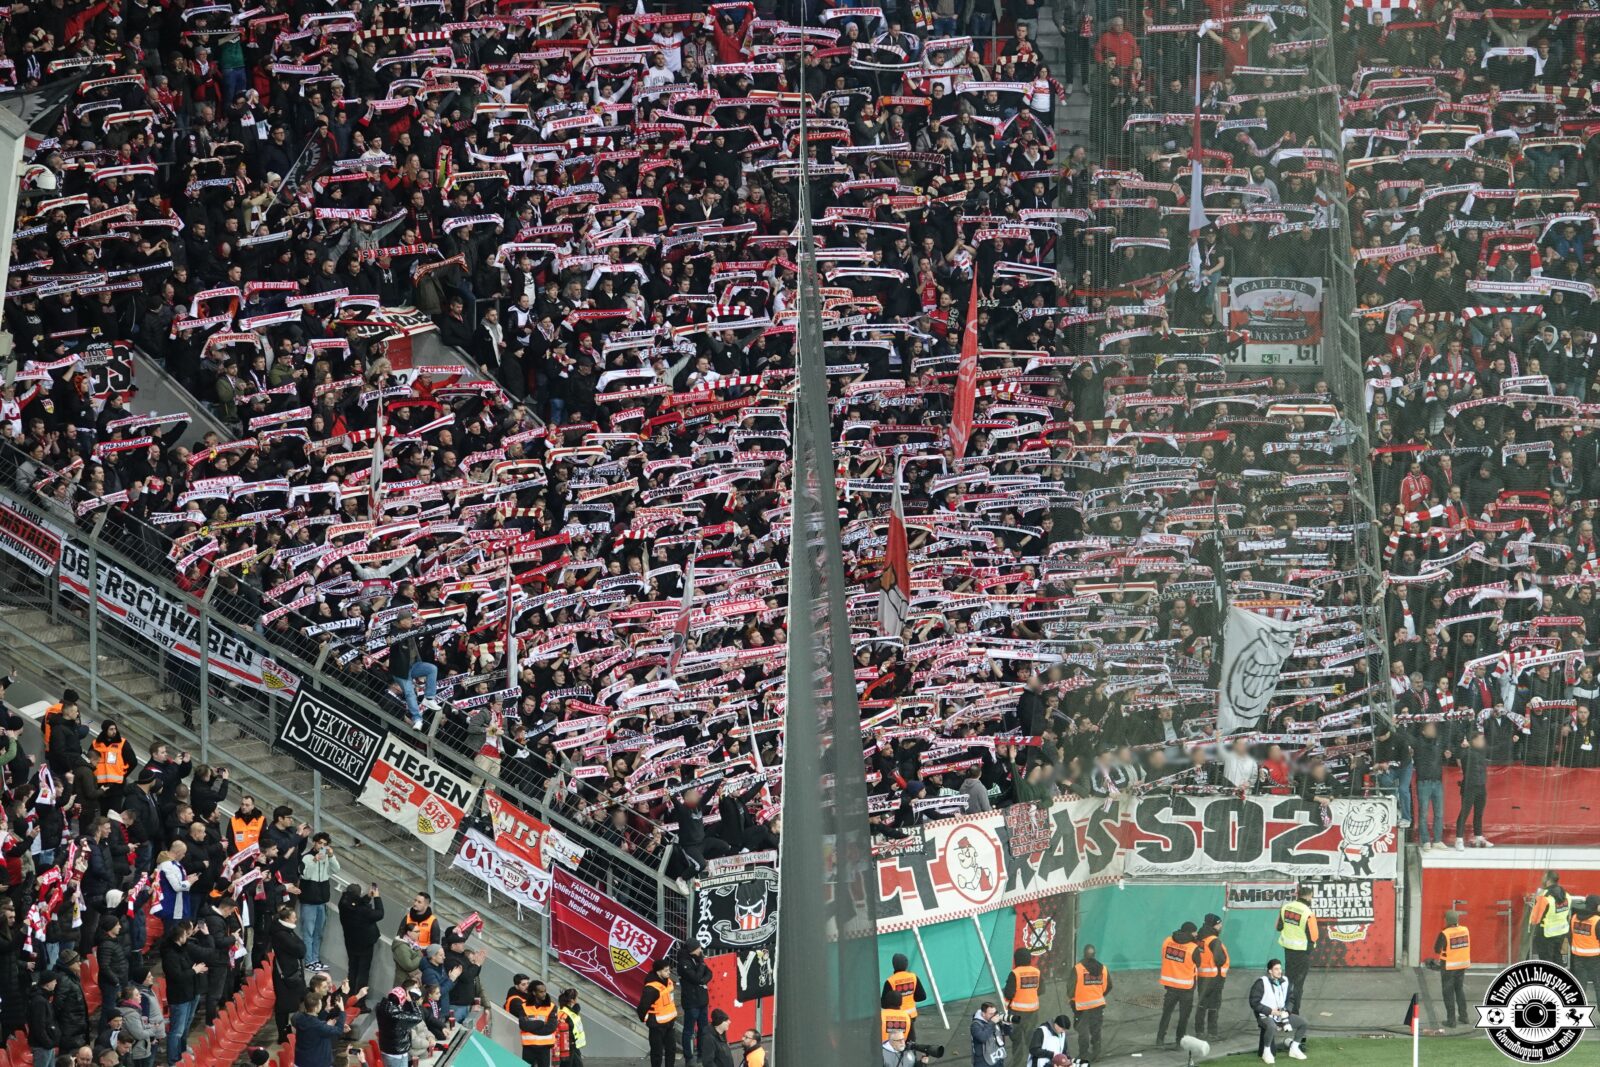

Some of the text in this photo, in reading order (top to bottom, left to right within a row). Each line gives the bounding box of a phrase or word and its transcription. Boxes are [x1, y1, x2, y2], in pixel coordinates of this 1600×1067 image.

[833, 8, 880, 16] STUTTGART
[552, 116, 595, 129] STUTTGART
[1241, 279, 1308, 292] GALEERE
[709, 401, 746, 410] STUTTGART
[492, 541, 507, 549] CC
[126, 612, 147, 630] SEIT
[383, 743, 471, 809] HESSEN
[498, 811, 540, 848] MTS
[902, 827, 921, 836] BIST
[571, 881, 600, 903] FANCLUB
[1301, 882, 1372, 897] LTRAS
[567, 900, 589, 917] Neuler
[611, 919, 655, 956] VfB
